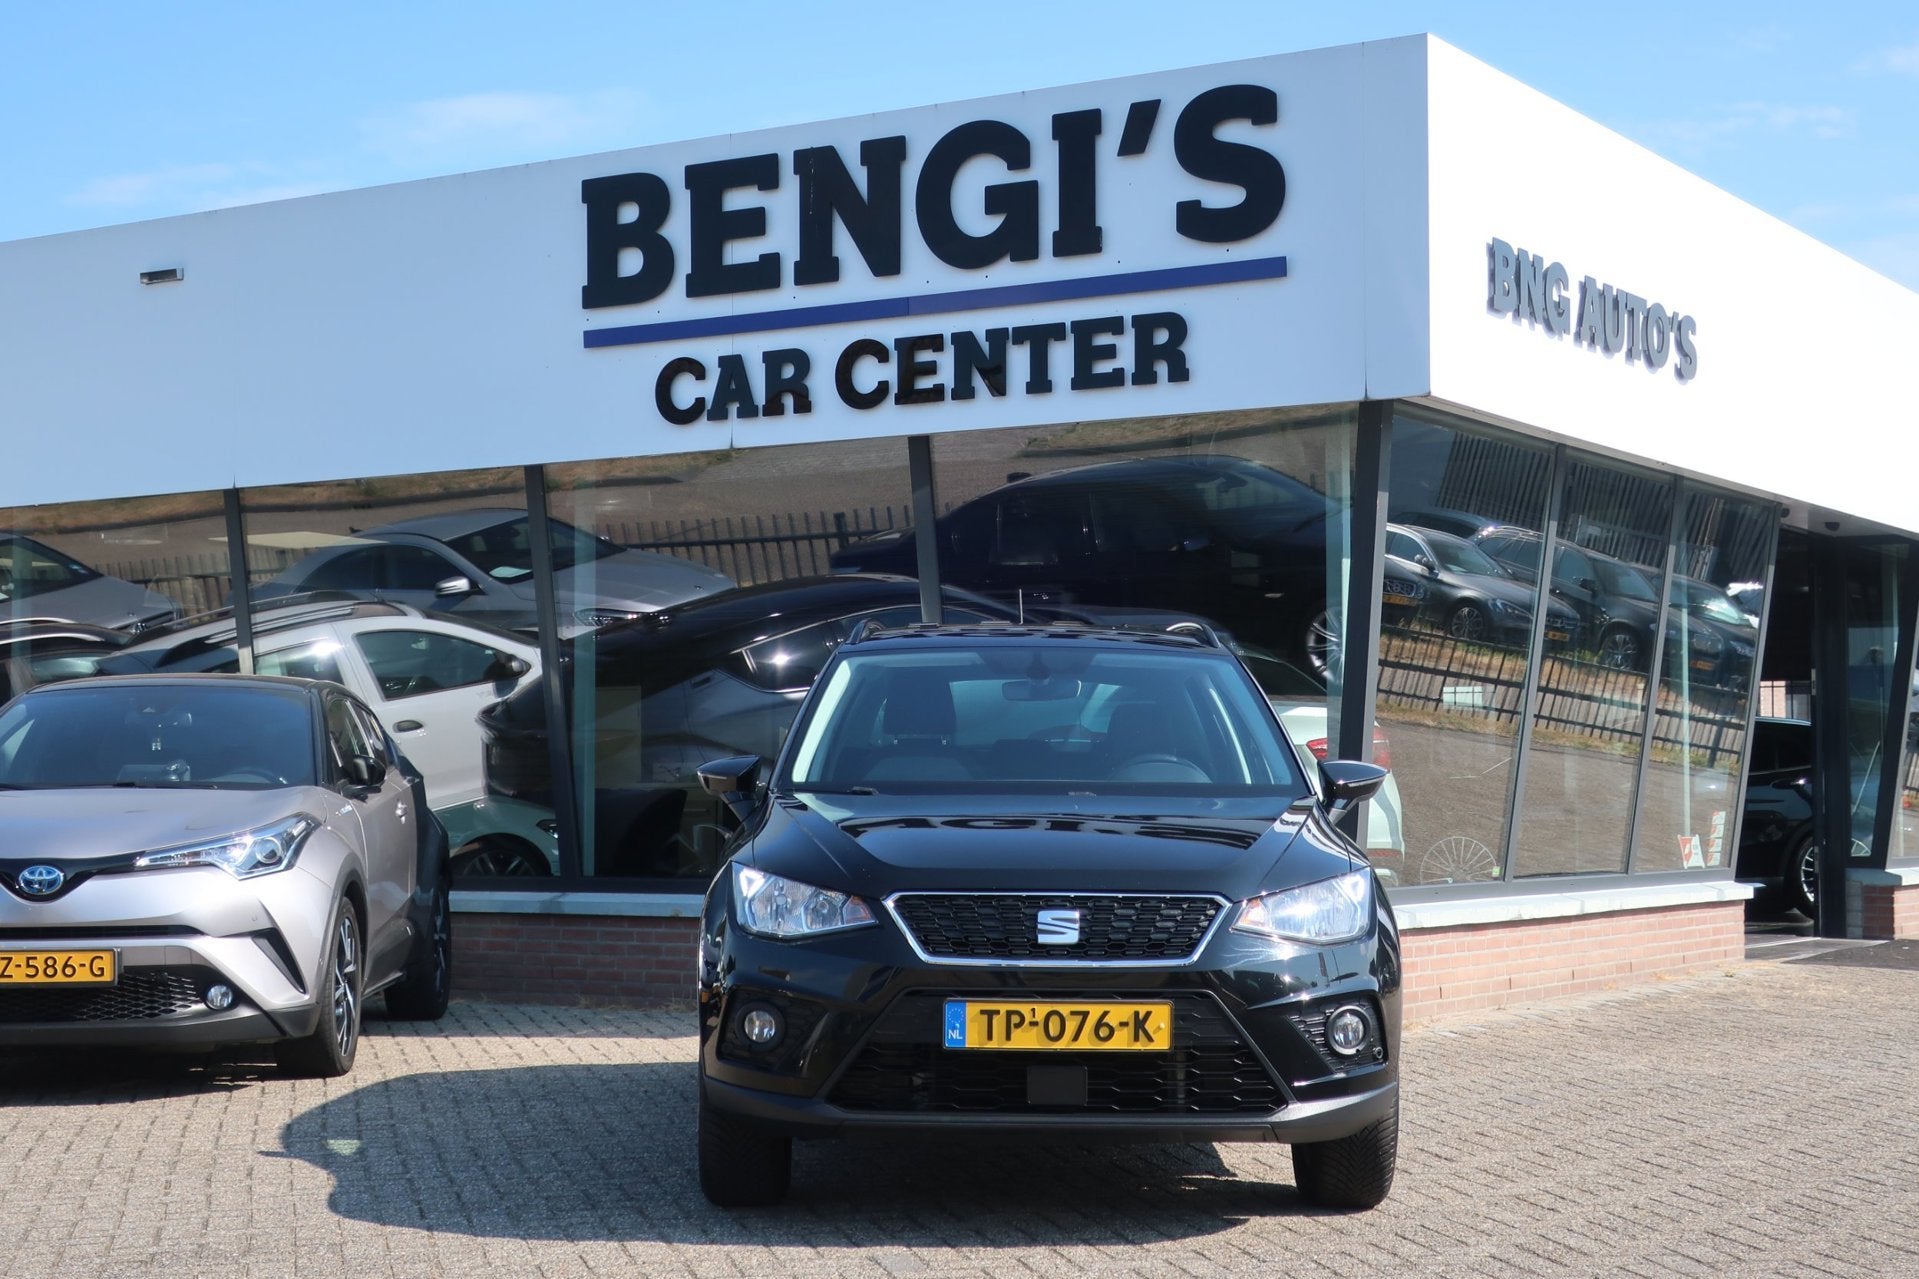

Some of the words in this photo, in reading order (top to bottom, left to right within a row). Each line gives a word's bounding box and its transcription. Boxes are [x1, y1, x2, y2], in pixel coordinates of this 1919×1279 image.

[581, 84, 1286, 309] BENGI'S
[655, 348, 812, 426] CAR
[834, 312, 1190, 410] CENTER
[1487, 237, 1571, 337] BNG
[1575, 275, 1697, 382] AUTO'S
[948, 1029, 963, 1040] NL
